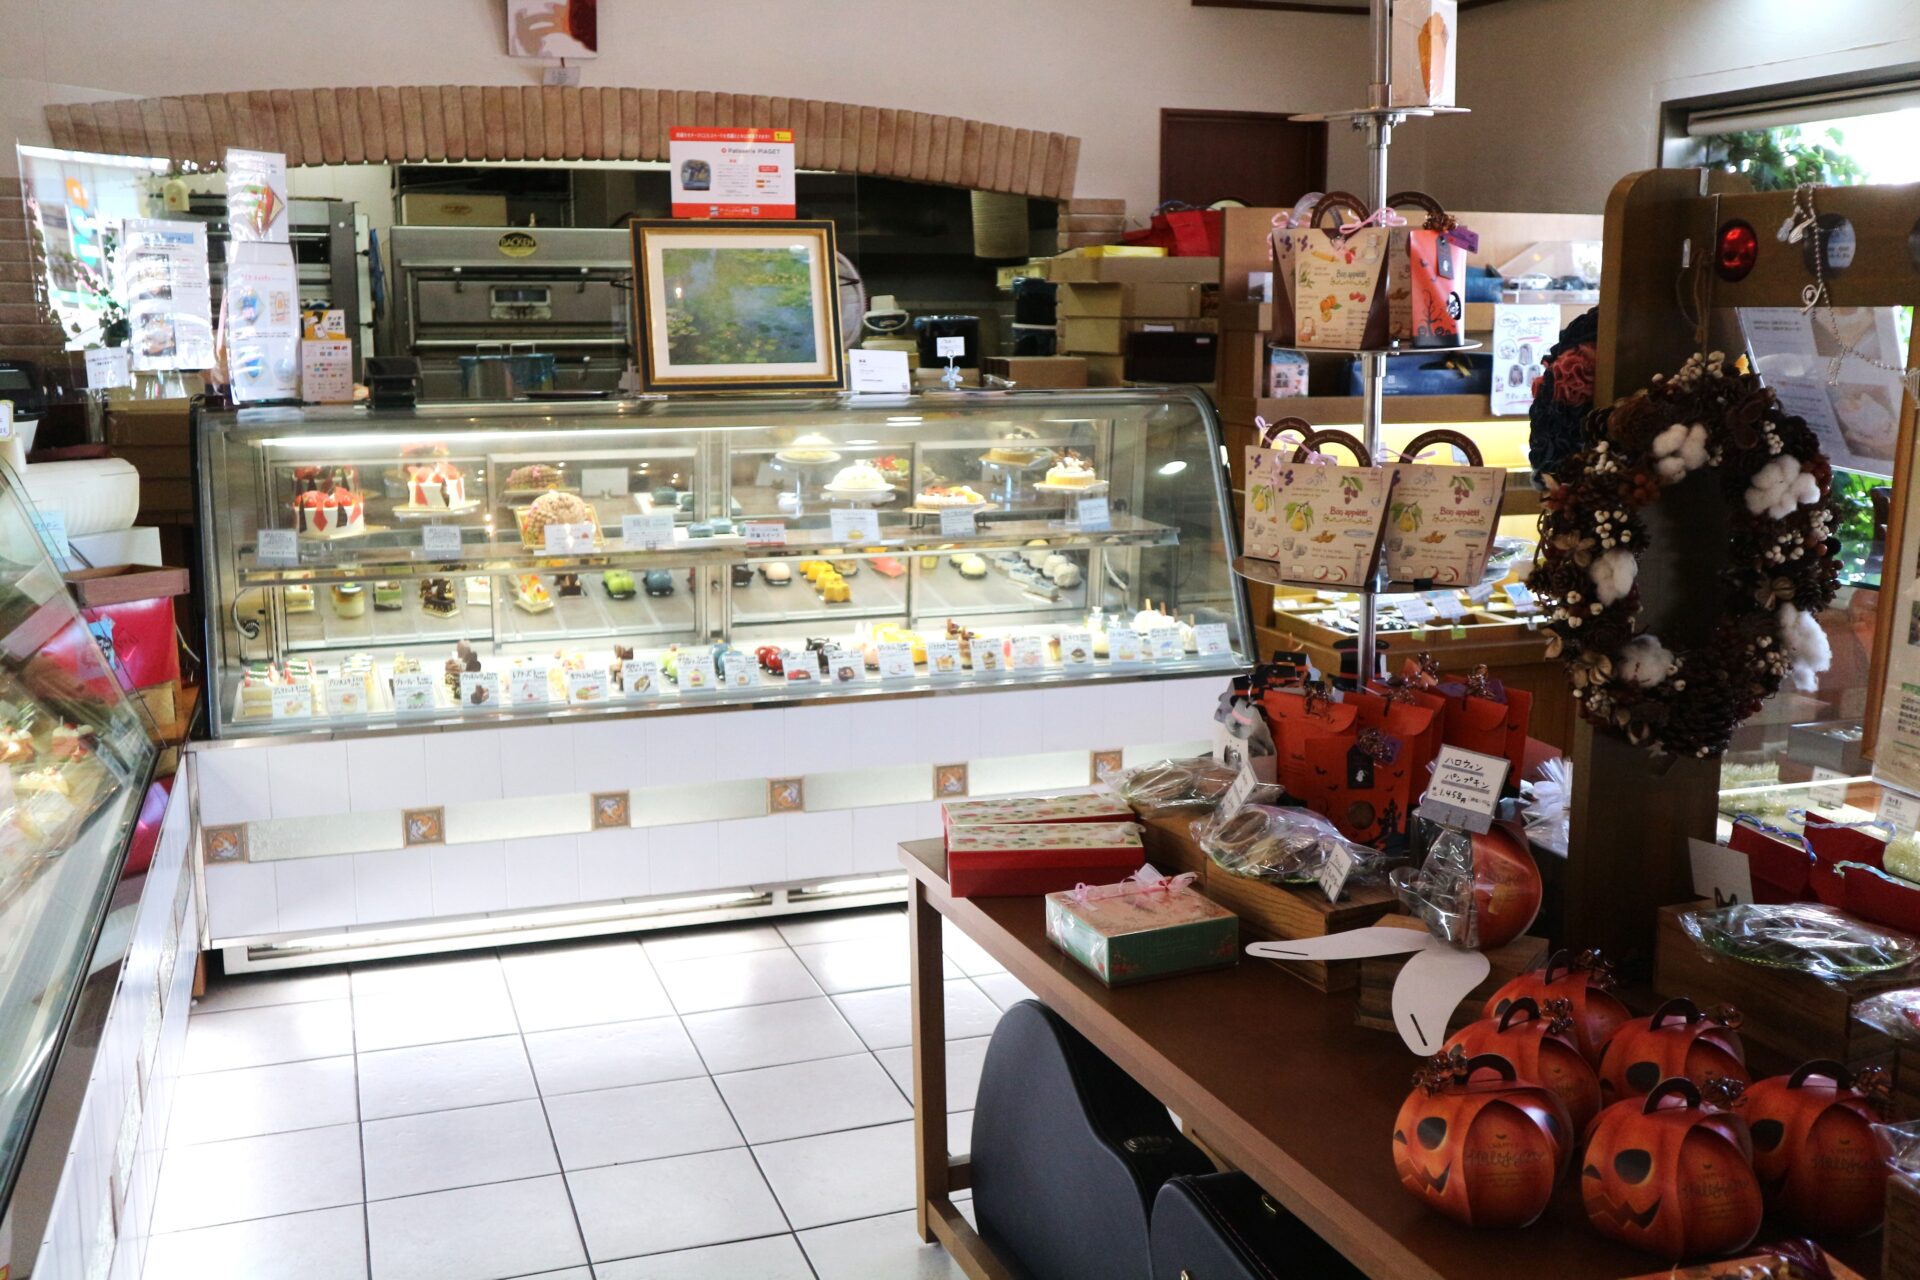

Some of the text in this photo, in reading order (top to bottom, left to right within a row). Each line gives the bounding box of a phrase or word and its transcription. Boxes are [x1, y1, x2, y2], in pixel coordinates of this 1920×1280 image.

[1329, 505, 1344, 516] Bon
[1439, 506, 1454, 516] Bon
[1445, 757, 1483, 771] ハロウィン
[1444, 773, 1489, 788] パンプキン
